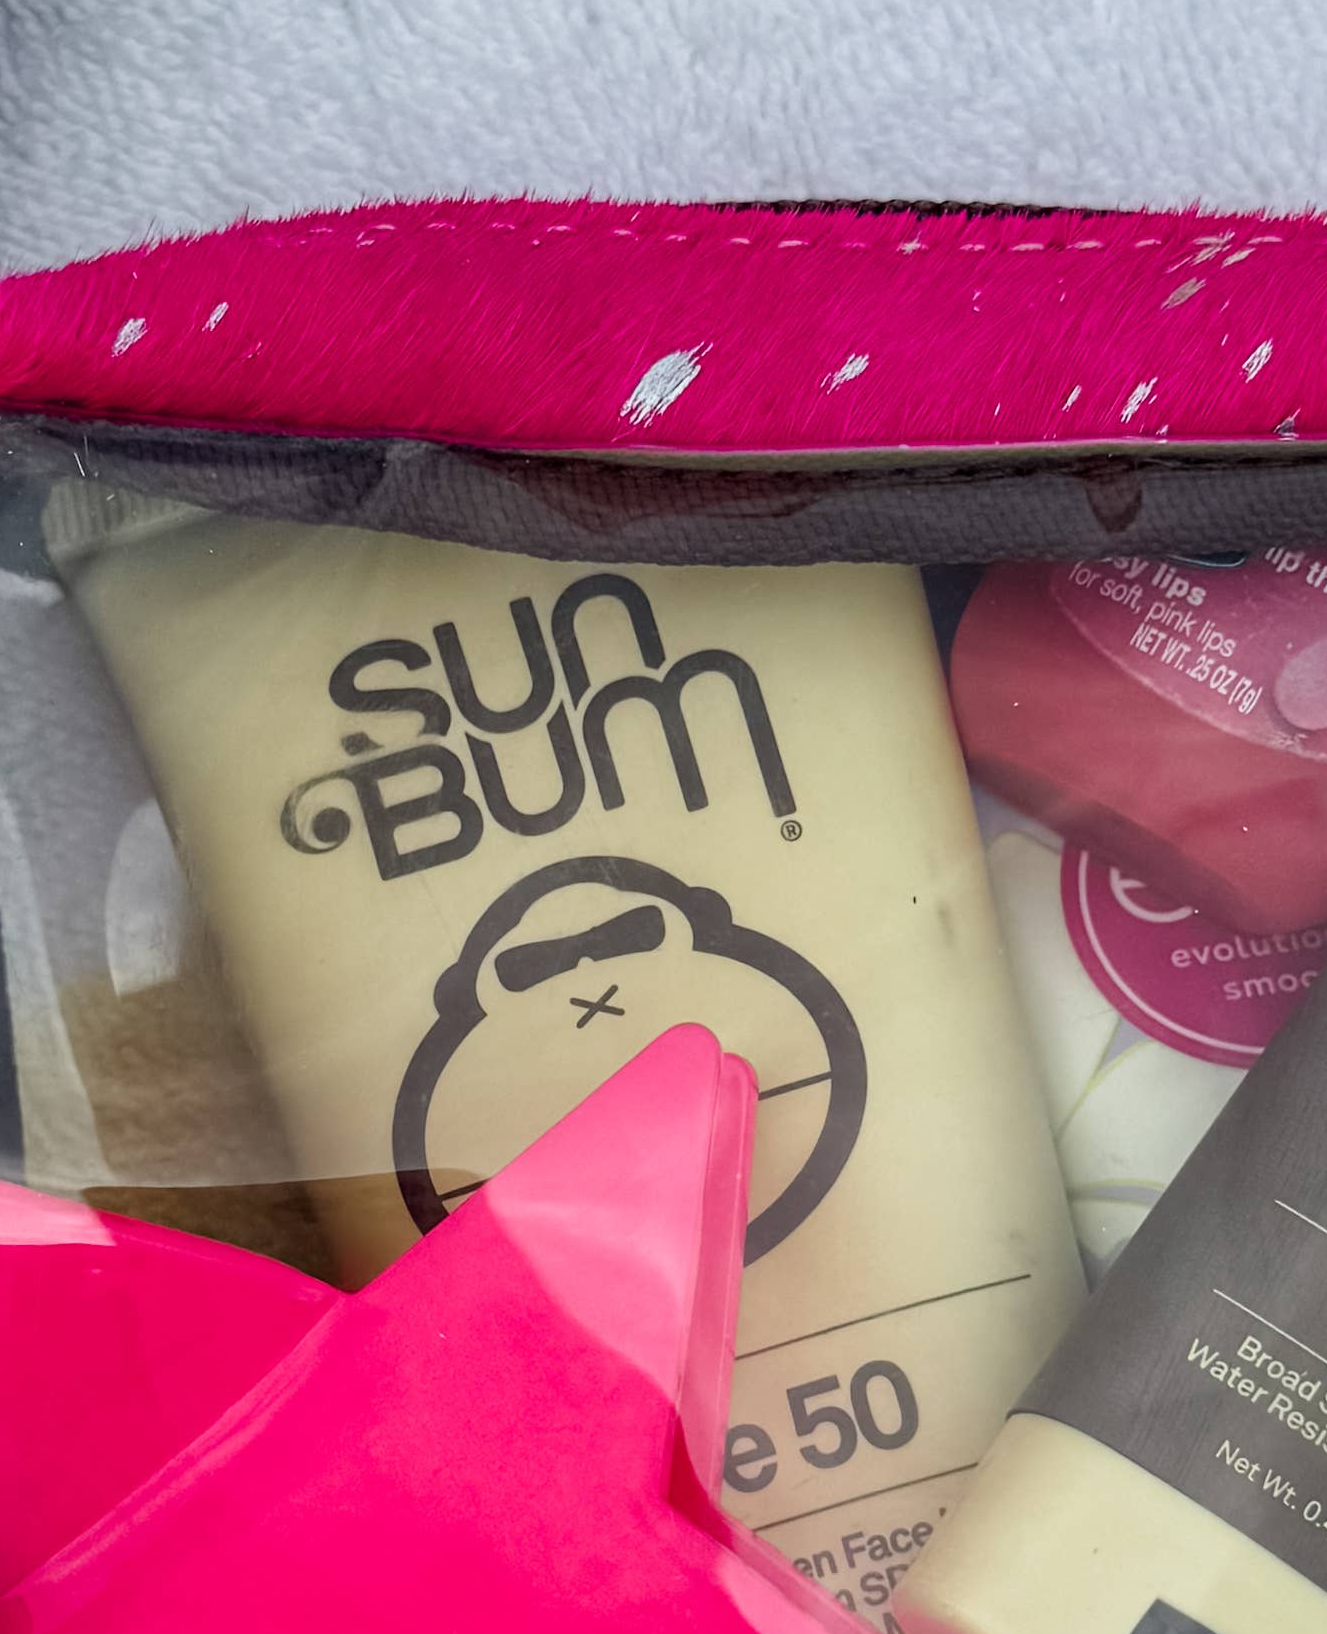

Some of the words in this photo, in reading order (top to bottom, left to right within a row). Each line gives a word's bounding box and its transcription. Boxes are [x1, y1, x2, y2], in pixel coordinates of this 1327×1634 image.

[1099, 577, 1144, 615] soft,
[1144, 600, 1200, 637] pink
[1196, 619, 1237, 658] lips
[1151, 563, 1208, 607] lips
[1129, 622, 1167, 657] NET
[1160, 637, 1192, 671] WT.
[1209, 664, 1238, 696] OZ
[1228, 676, 1264, 715] (7g)
[1186, 1337, 1269, 1404] Water
[1236, 1335, 1322, 1402] Broad
[785, 1359, 919, 1470] 50
[1215, 1439, 1262, 1483] Net
[1262, 1469, 1297, 1511] Wt.
[840, 1520, 935, 1569] Face
